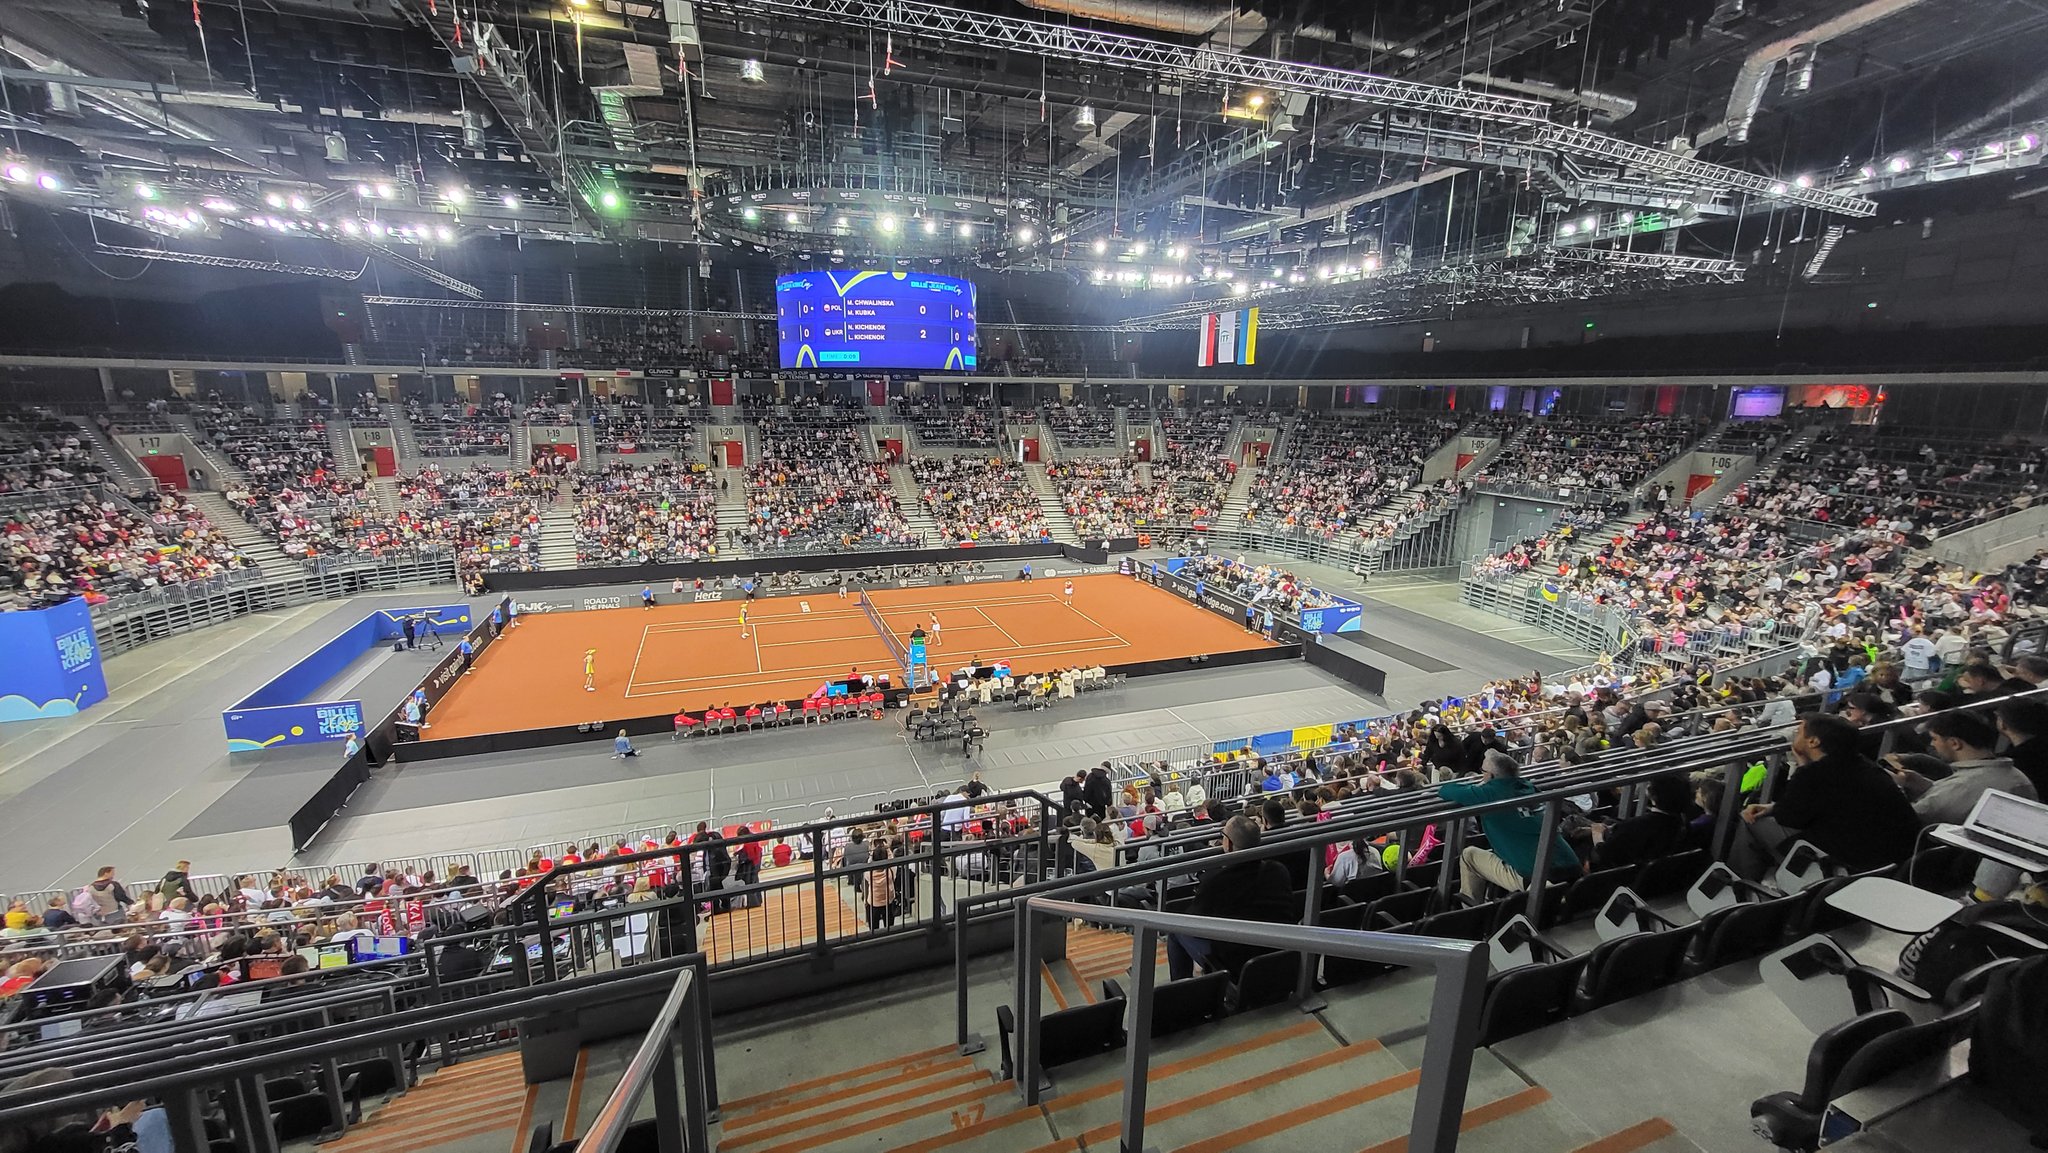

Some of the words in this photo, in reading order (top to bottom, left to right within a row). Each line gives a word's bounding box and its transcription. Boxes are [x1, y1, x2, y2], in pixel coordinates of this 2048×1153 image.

[803, 304, 809, 314] 0
[919, 305, 926, 315] 0
[954, 309, 960, 318] 0
[804, 329, 810, 338] 0
[920, 329, 927, 339] 2
[954, 332, 960, 341] 0
[546, 429, 561, 438] 1-19
[719, 427, 734, 436] 1-20
[881, 426, 894, 436] 1-01
[1016, 426, 1030, 435] 1-02
[1133, 427, 1146, 436] 1-03
[1253, 430, 1267, 438] 1-04
[362, 431, 381, 441] 1-18
[139, 437, 161, 449] 1-17
[1470, 440, 1486, 450] 1-05
[1711, 456, 1732, 469] 1-06
[1090, 566, 1120, 574] GAINBRIDGE
[694, 590, 723, 601] Hertz
[1177, 584, 1189, 596] visit
[1187, 589, 1236, 615] garidge.com
[56, 630, 89, 651] BILLIE
[439, 667, 452, 684] visit
[316, 707, 357, 719] BILLIE
[318, 715, 359, 726] JEAN
[319, 723, 359, 735] KING
